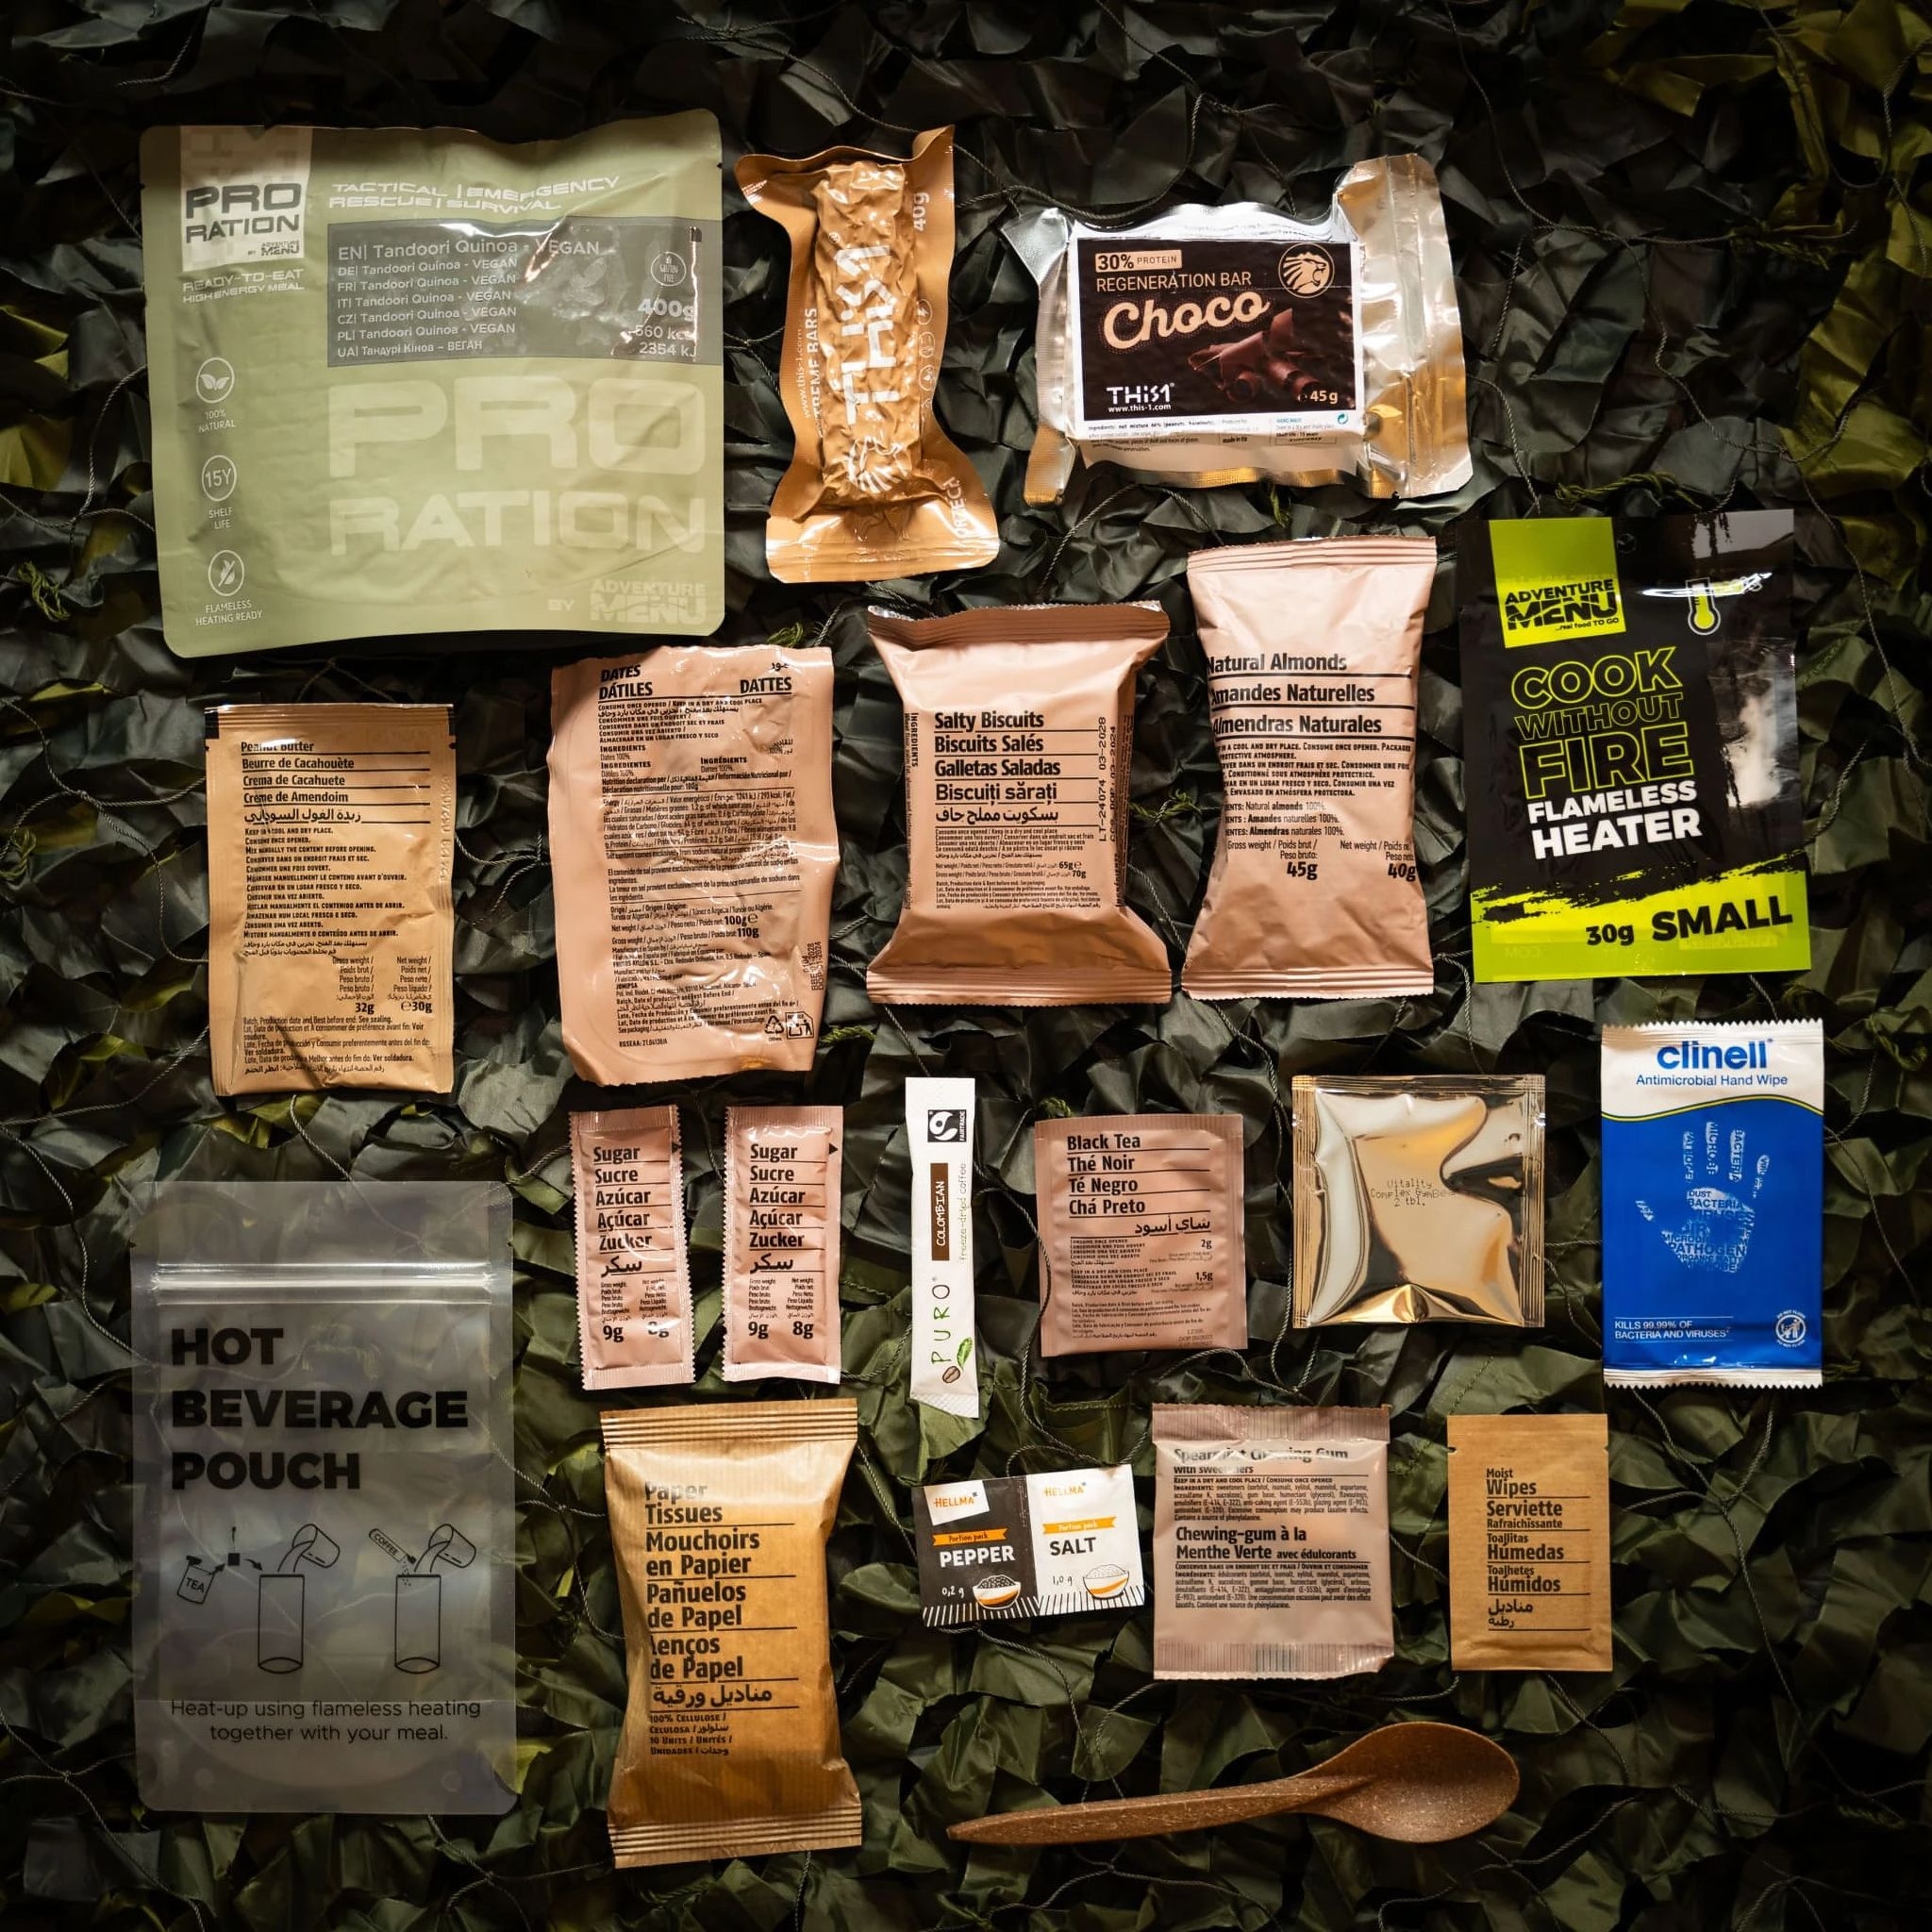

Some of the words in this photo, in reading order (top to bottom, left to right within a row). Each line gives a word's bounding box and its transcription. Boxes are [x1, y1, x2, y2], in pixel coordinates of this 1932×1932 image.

[332, 182, 447, 196] TACTICAL
[467, 176, 620, 202] EMERGENCY
[186, 183, 301, 219] PRO
[329, 196, 431, 208] RESCUE
[446, 200, 562, 215] SURVIVAL
[913, 193, 930, 231] 40g
[186, 215, 299, 243] RATION
[374, 241, 450, 258] Tandoori
[456, 240, 517, 254] Quinoa
[535, 238, 600, 255] VEGAN
[1098, 255, 1134, 270] 30%
[1138, 256, 1177, 264] PROTEIN
[184, 269, 303, 291] READY-TO-EAT
[1097, 274, 1215, 292] REGENERATION
[1221, 272, 1251, 286] BAR
[183, 293, 212, 303] HIGH
[213, 285, 264, 299] ENERGY
[267, 283, 305, 291] MEAL
[638, 299, 694, 322] 400g
[1104, 291, 1270, 349] Choco
[806, 308, 818, 353] BARS
[1108, 404, 1171, 412] www.this-1.com
[327, 376, 705, 476] PRO
[205, 468, 231, 487] 15Y
[208, 508, 232, 518] SHELF
[215, 521, 230, 529] LIFE
[330, 491, 705, 555] RATION
[1505, 579, 1614, 605] ADVENTURE
[1506, 591, 1617, 630] MENU
[601, 665, 641, 682] DATES
[1208, 654, 1265, 675] Natural
[1271, 653, 1347, 671] Almonds
[741, 677, 791, 693] DATTES
[1512, 646, 1683, 709] COOK
[1288, 684, 1374, 702] Naturelles
[935, 712, 975, 734] Salty
[981, 710, 1043, 728] Biscuits
[1213, 715, 1292, 735] Almendras
[1300, 715, 1382, 733] Naturales
[1514, 692, 1683, 741] WITHOUT
[935, 736, 996, 752] Biscuits
[1002, 734, 1043, 751] Salés
[242, 759, 275, 769] Beurre
[278, 758, 291, 768] de
[295, 758, 354, 768] Cacahouète
[936, 760, 997, 776] Galletas
[1002, 759, 1059, 775] Saladas
[1519, 722, 1693, 800] FIRE
[243, 775, 272, 786] Crema
[275, 774, 288, 785] de
[292, 775, 344, 785] Cacahuete
[275, 791, 288, 802] de
[291, 791, 348, 802] Amendoim
[1528, 781, 1697, 824] FLAMELESS
[1531, 808, 1702, 859] HEATER
[1059, 861, 1073, 870] 65g
[1073, 870, 1086, 878] 70g
[1288, 862, 1317, 880] 45g
[1389, 863, 1416, 881] 40g
[724, 916, 746, 926] 100g
[1586, 924, 1634, 945] 30g
[1651, 895, 1792, 941] SMALL
[737, 928, 759, 938] 110g
[356, 1003, 375, 1014] 32g
[1657, 1041, 1767, 1069] clinell
[1637, 1074, 1716, 1086] Antimicrobial
[1722, 1075, 1753, 1085] Hand
[1757, 1075, 1787, 1087] Wipe
[1068, 1135, 1108, 1150] Black
[1114, 1134, 1140, 1148] Tea
[751, 1144, 797, 1162] Sugar
[1068, 1155, 1096, 1172] Thé
[1103, 1156, 1134, 1170] Noir
[750, 1166, 793, 1182] Sucre
[1070, 1177, 1085, 1192] Té
[1091, 1178, 1138, 1194] Negro
[750, 1188, 805, 1204] Azúcar
[1394, 1198, 1400, 1207] 2
[1406, 1197, 1424, 1206] tbl.
[936, 1181, 945, 1246] COLOMBIAN
[1070, 1199, 1096, 1214] Chá
[1104, 1199, 1145, 1213] Preto
[750, 1210, 802, 1227] Açúcar
[750, 1233, 805, 1247] Zucker
[1201, 1240, 1211, 1249] 2g
[751, 1254, 793, 1274] سكر
[1196, 1272, 1213, 1281] 1,5g
[748, 1322, 768, 1339] 9g
[793, 1322, 813, 1339] 8g
[932, 1284, 951, 1364] PURO
[1615, 1321, 1641, 1329] KILLS
[1615, 1330, 1661, 1339] BACTERIA
[172, 1327, 283, 1366] HOT
[172, 1390, 467, 1428] BEVERAGE
[172, 1452, 359, 1490] POUCH
[1487, 1468, 1513, 1478] Moist
[645, 1482, 707, 1503] Paper
[1043, 1486, 1084, 1496] HELLMA
[1487, 1479, 1537, 1498] Wipes
[934, 1496, 974, 1507] HELLMA
[1487, 1500, 1562, 1516] Serviette
[645, 1503, 723, 1524] Tissues
[647, 1527, 759, 1551] Mouchoirs
[1176, 1526, 1275, 1543] Chewing-gum
[1281, 1525, 1289, 1540] à
[1294, 1526, 1306, 1541] la
[374, 1532, 399, 1557] COFFEE
[1050, 1538, 1096, 1556] SALT
[1176, 1545, 1230, 1558] Menthe
[1236, 1545, 1272, 1558] Verte
[1276, 1551, 1298, 1559] avec
[1302, 1549, 1357, 1559] édulcorants
[647, 1559, 672, 1576] en
[681, 1552, 751, 1579] Papier
[941, 1546, 1015, 1568] PEPPER
[186, 1576, 205, 1593] TEA
[647, 1581, 746, 1603] Pañuelos
[648, 1608, 674, 1628] de
[683, 1605, 741, 1630] Papel
[651, 1658, 674, 1679] de
[683, 1657, 742, 1682] Papel
[172, 1701, 248, 1720] Heat-up
[255, 1701, 304, 1720] using
[312, 1700, 401, 1717] flameless
[409, 1701, 480, 1720] heating
[210, 1724, 292, 1743] together
[301, 1724, 341, 1741] with
[348, 1727, 390, 1743] your
[397, 1725, 448, 1740] meal.
